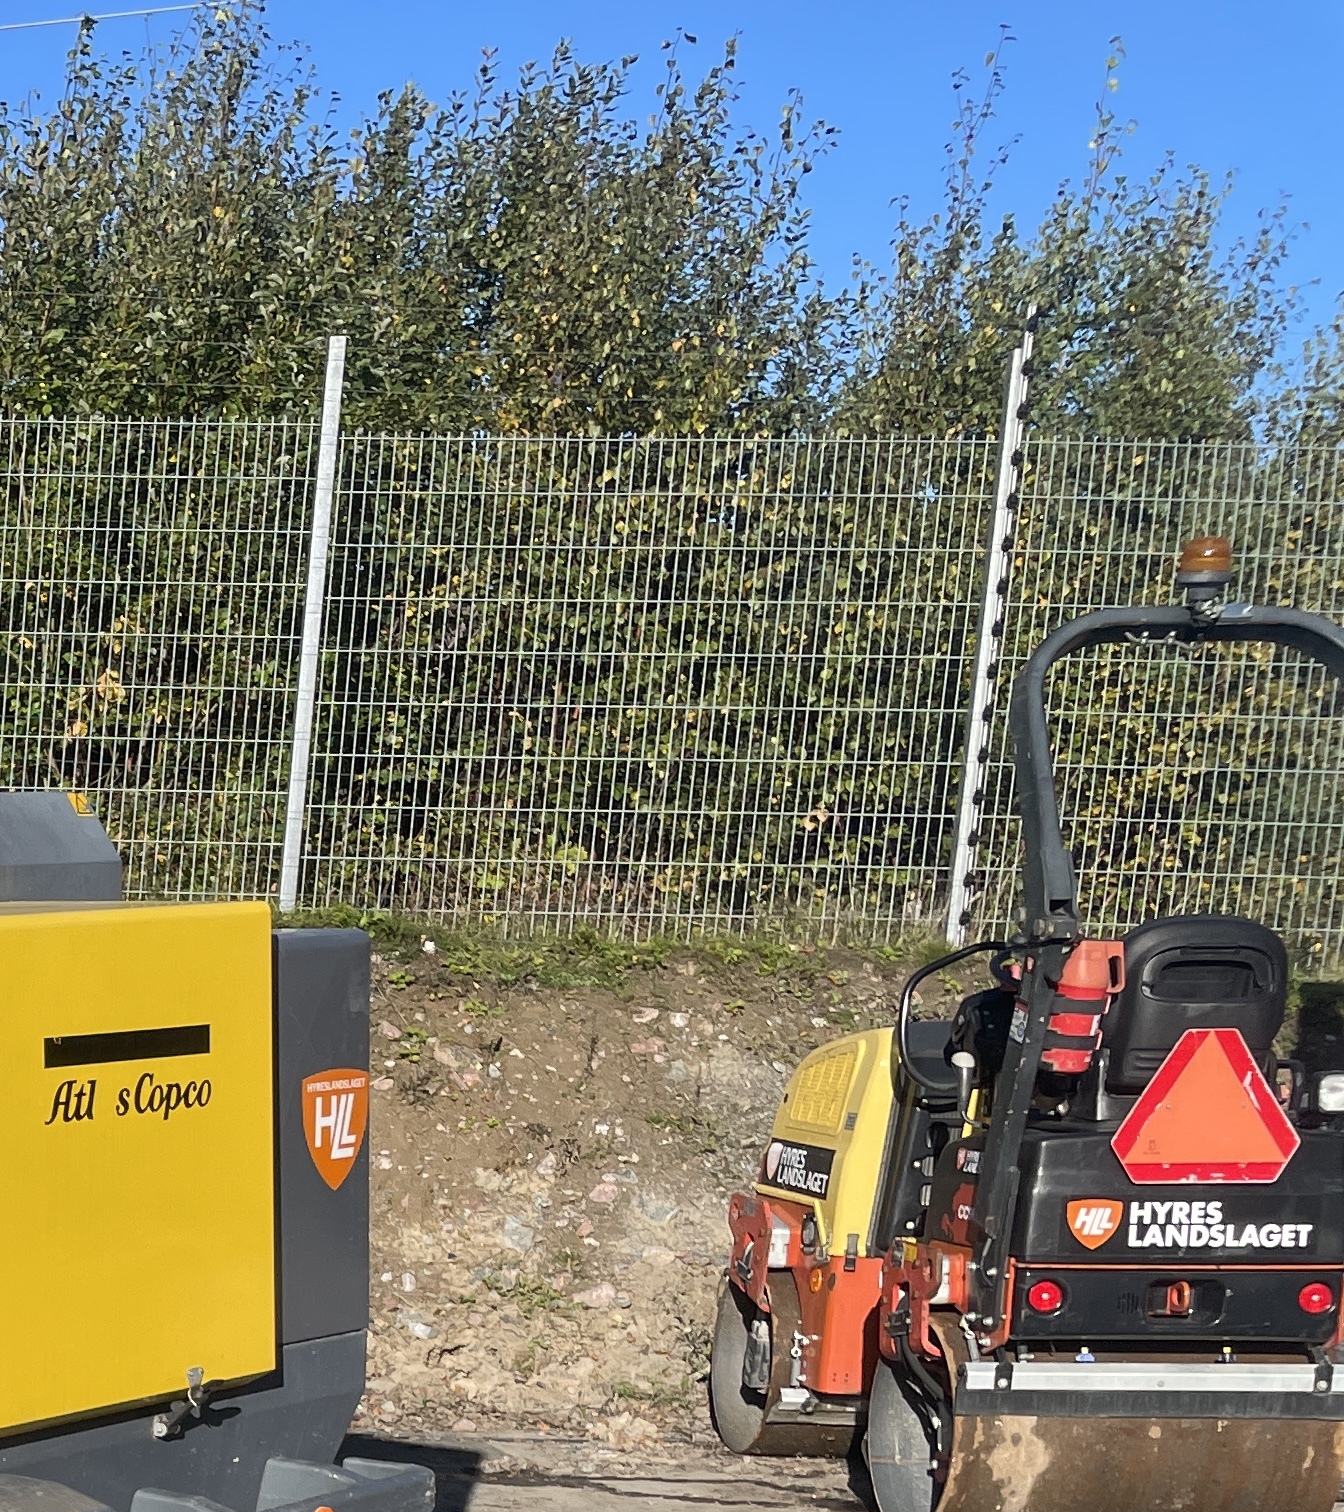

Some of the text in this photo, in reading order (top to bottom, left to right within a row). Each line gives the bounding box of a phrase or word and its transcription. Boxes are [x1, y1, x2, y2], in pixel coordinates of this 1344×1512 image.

[306, 1077, 366, 1093] HYRESLANDSLAGET
[780, 1146, 808, 1169] HYRES
[777, 1164, 829, 1194] LANDSLAGET
[1074, 1207, 1113, 1236] HLL
[1129, 1201, 1223, 1226] HYRES
[1127, 1223, 1314, 1248] LANDSLAGET
